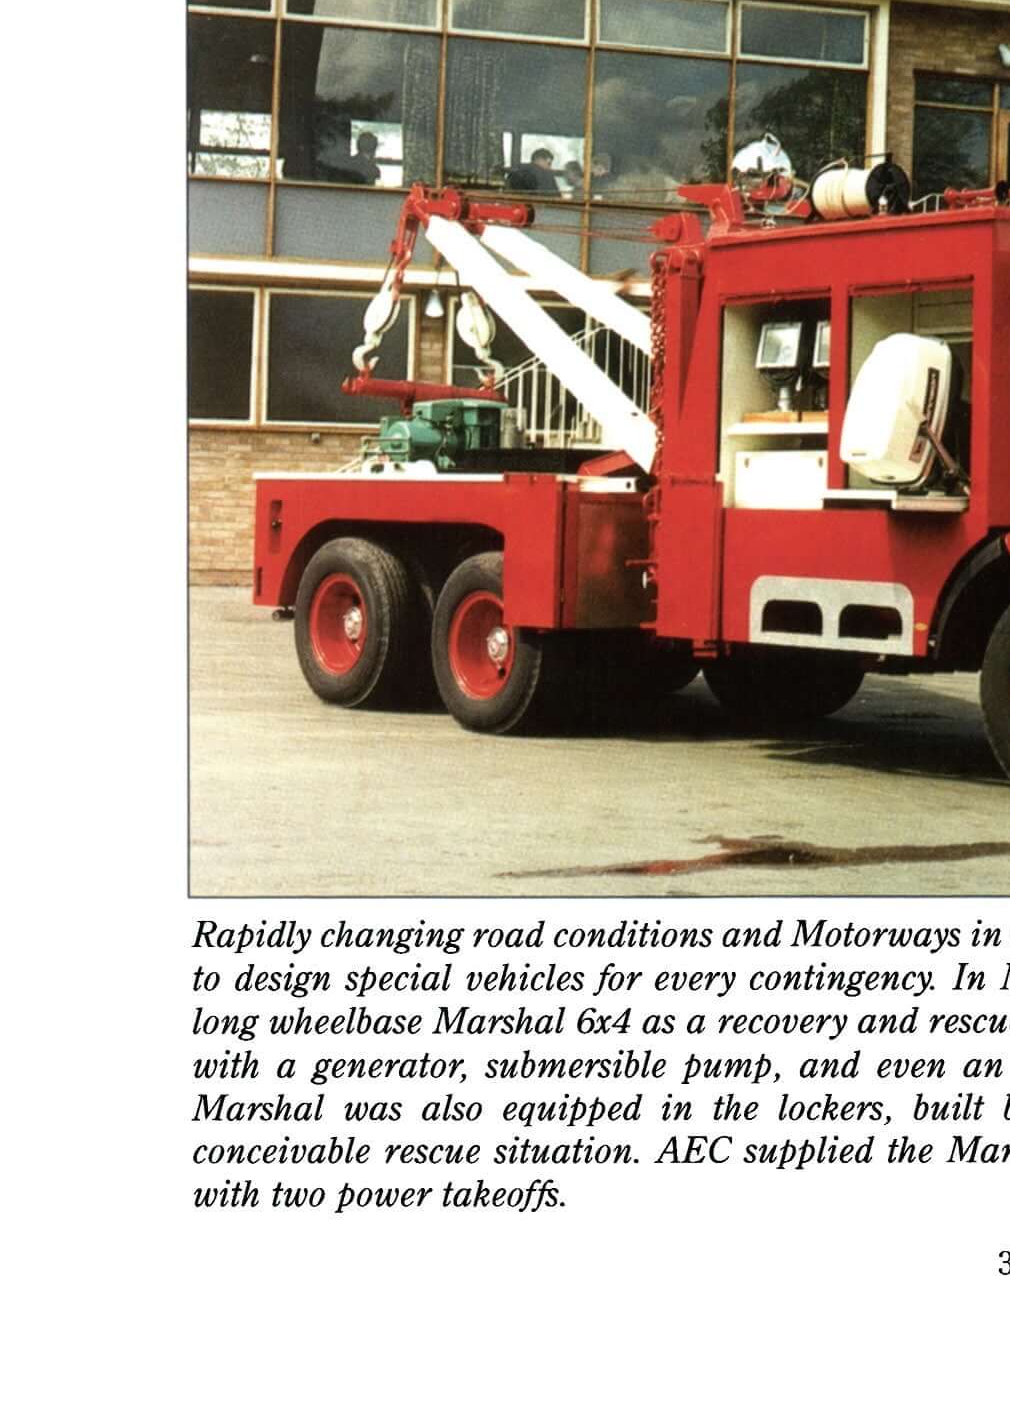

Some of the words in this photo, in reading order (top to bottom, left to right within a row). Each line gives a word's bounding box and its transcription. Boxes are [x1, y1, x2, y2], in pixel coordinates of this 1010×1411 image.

[191, 919, 312, 955] Rapidly
[320, 919, 465, 955] changing
[473, 920, 546, 948] road
[553, 919, 714, 948] conditions
[722, 919, 784, 948] and
[789, 919, 961, 954] Motorways
[971, 919, 1002, 948] in
[192, 965, 221, 992] to
[234, 962, 331, 998] design
[344, 962, 453, 998] special
[466, 962, 585, 992] vehicles
[592, 962, 643, 997] for
[654, 971, 737, 998] every
[749, 961, 935, 998] contingency.
[951, 962, 986, 991] In
[193, 1049, 259, 1079] with
[276, 1058, 296, 1079] a
[310, 1052, 467, 1086] generator,
[484, 1049, 667, 1079] submersible
[680, 1053, 781, 1085] pump,
[799, 1049, 861, 1079] and
[876, 1058, 946, 1079] even
[962, 1058, 1003, 1078] an
[191, 1093, 325, 1122] Marshal
[344, 1101, 403, 1122] was
[421, 1093, 483, 1122] also
[502, 1093, 643, 1128] equipped
[661, 1093, 693, 1122] in
[713, 1093, 759, 1122] the
[778, 1093, 892, 1126] lockers,
[913, 1092, 985, 1121] built
[192, 1135, 371, 1165] conceivable
[384, 1144, 481, 1165] rescue
[493, 1135, 639, 1165] situation.
[653, 1135, 733, 1164] AEC
[743, 1135, 875, 1170] supplied
[887, 1135, 934, 1164] the
[193, 1179, 260, 1208] with
[271, 1181, 326, 1208] two
[334, 1182, 433, 1214] power
[442, 1178, 566, 1213] takeoffs.
